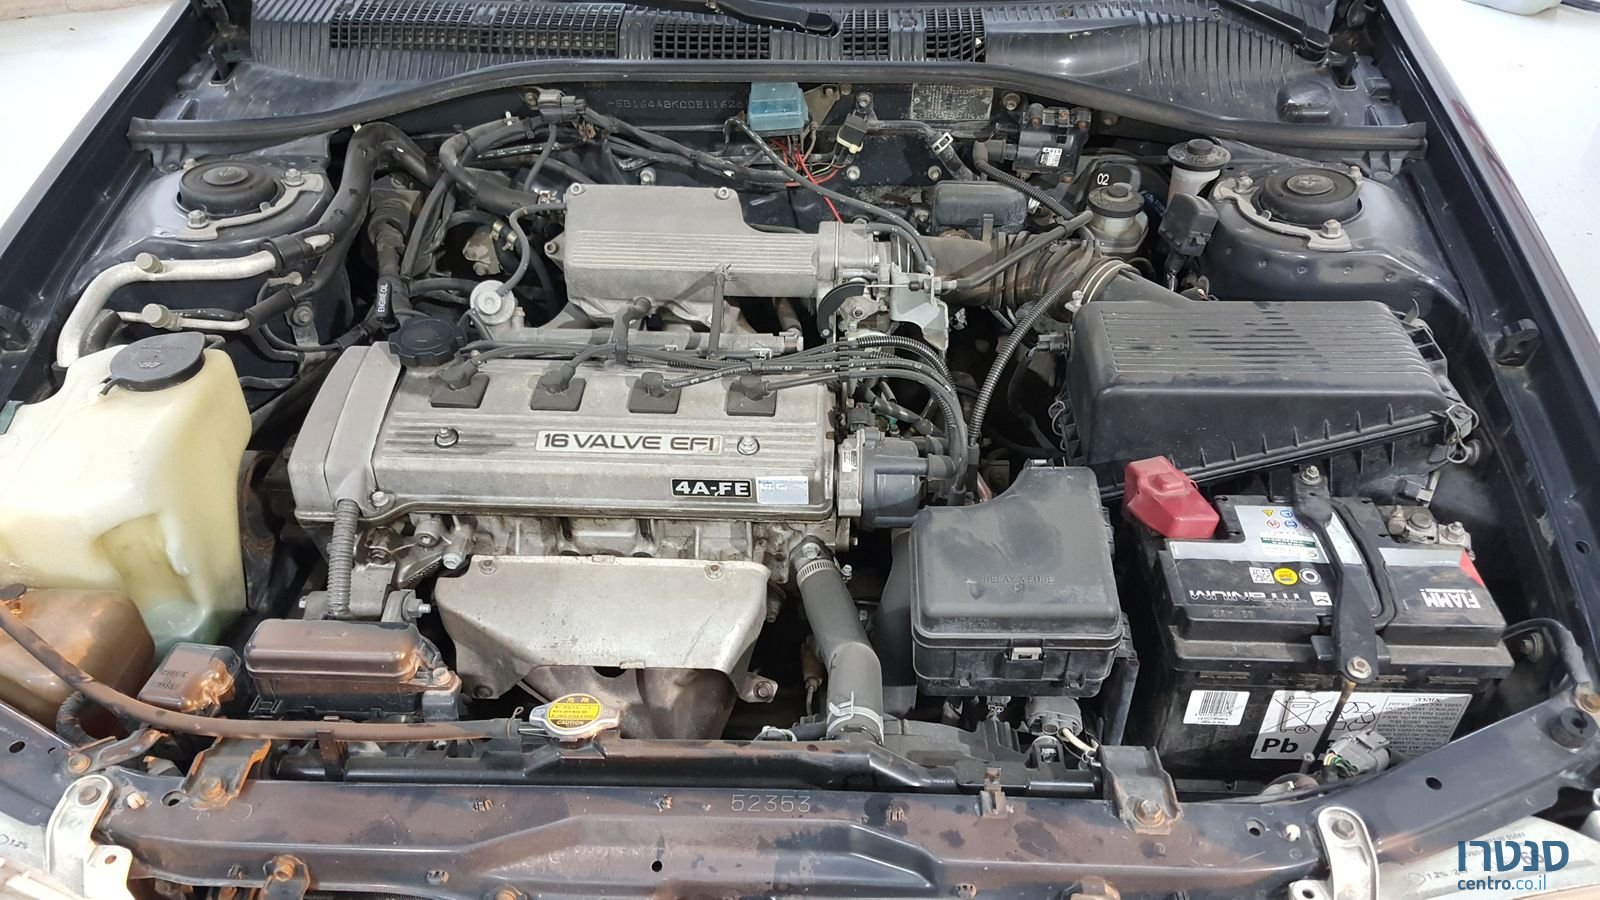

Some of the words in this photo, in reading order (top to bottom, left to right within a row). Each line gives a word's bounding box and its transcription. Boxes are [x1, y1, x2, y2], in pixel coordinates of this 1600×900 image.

[1096, 172, 1110, 186] 02
[543, 432, 569, 448] 16
[573, 433, 662, 450] VALVE
[670, 435, 715, 451] EFI
[675, 480, 750, 497] 4A-FE
[1419, 588, 1481, 609] FIAMM
[1260, 738, 1299, 753] Pb
[731, 794, 811, 813] 52353
